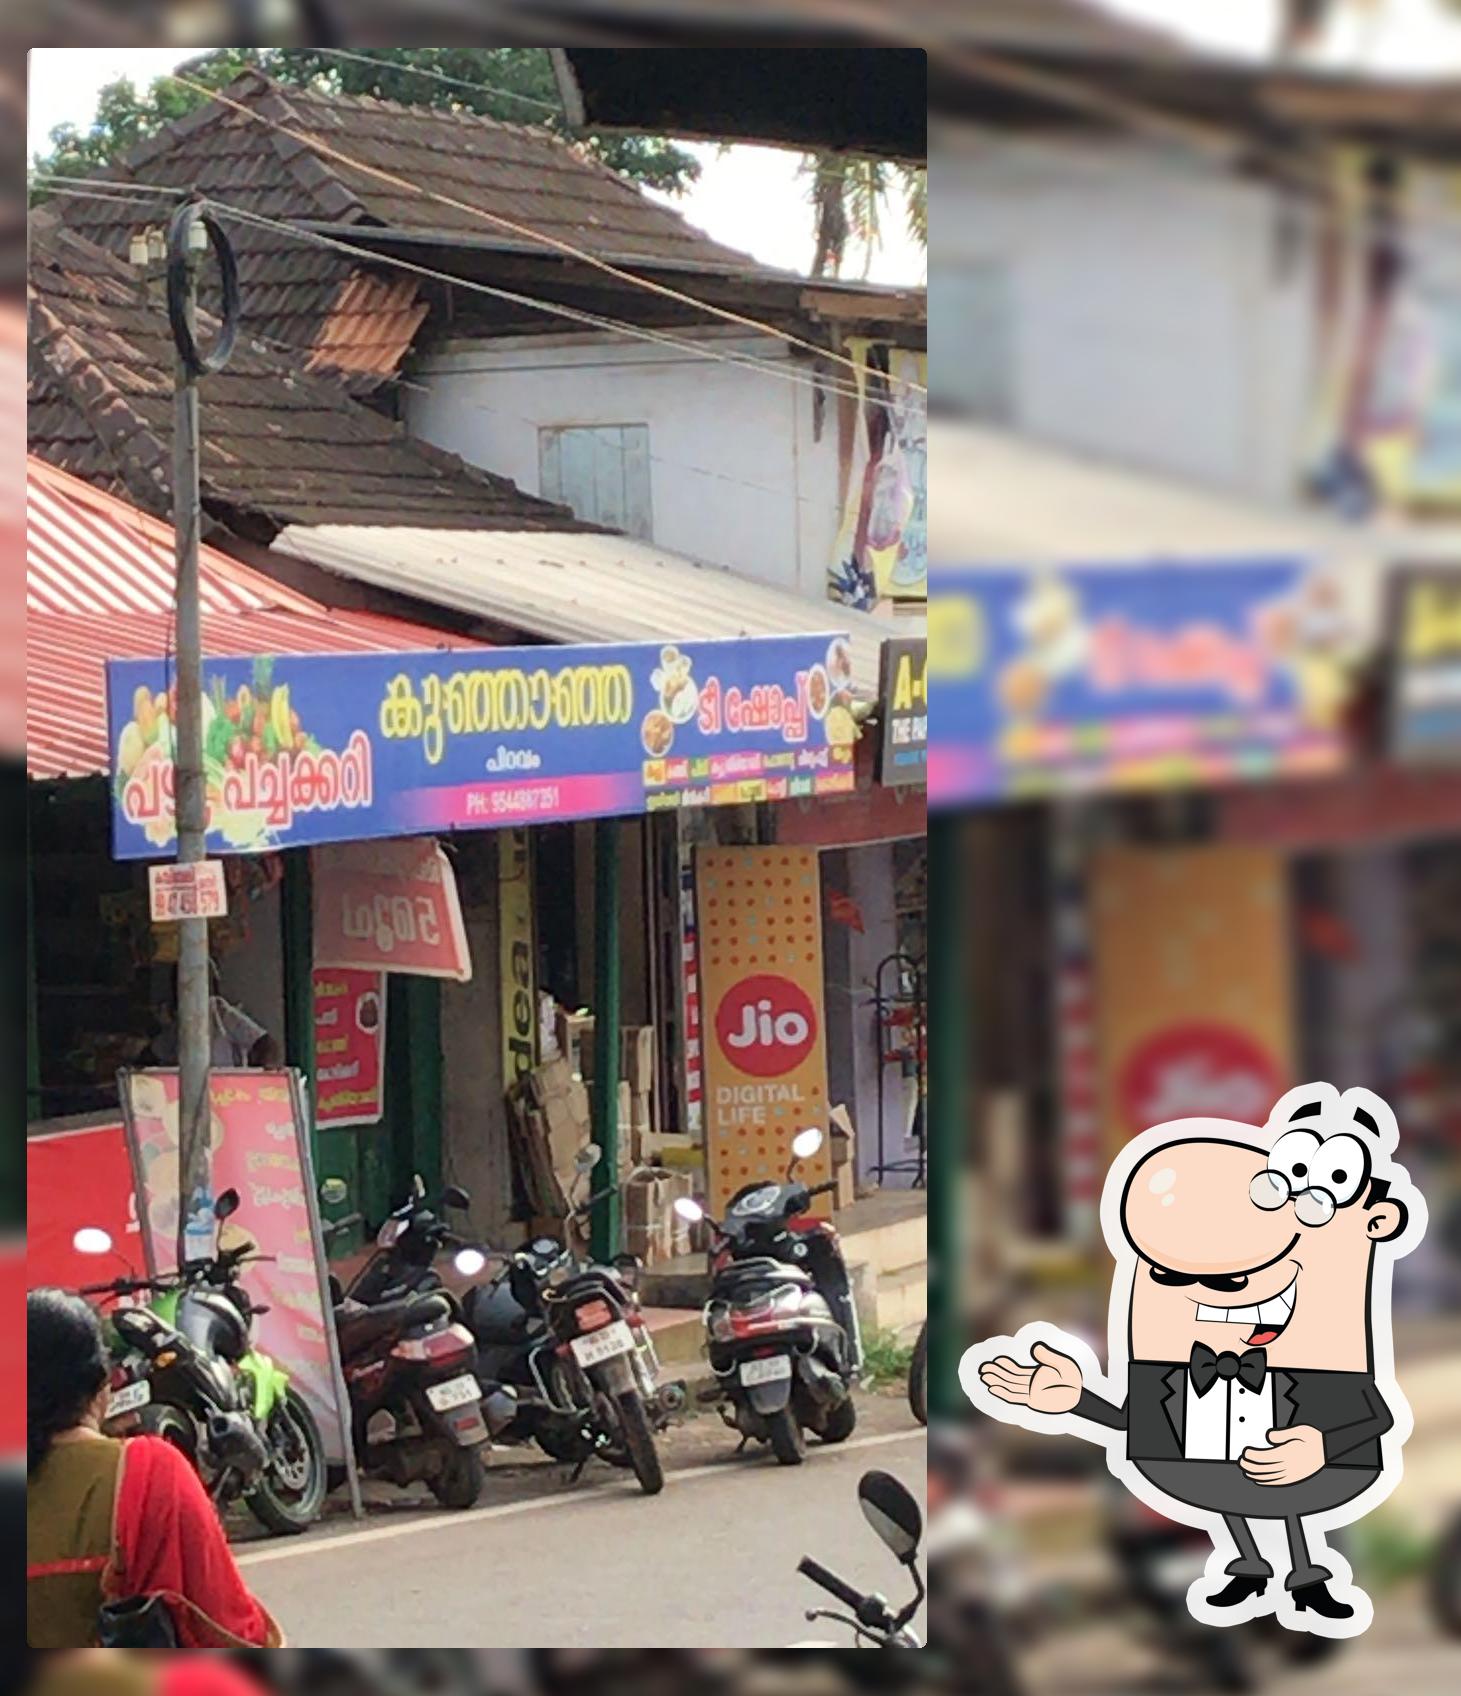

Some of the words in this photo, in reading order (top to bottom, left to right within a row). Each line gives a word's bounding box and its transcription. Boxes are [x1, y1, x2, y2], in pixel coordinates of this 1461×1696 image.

[892, 654, 927, 711] A-
[223, 730, 372, 829] പച്ചക്കറി
[727, 1000, 809, 1048] Jio
[716, 1083, 805, 1105] DIGITAL
[716, 1105, 767, 1126] LIFE
